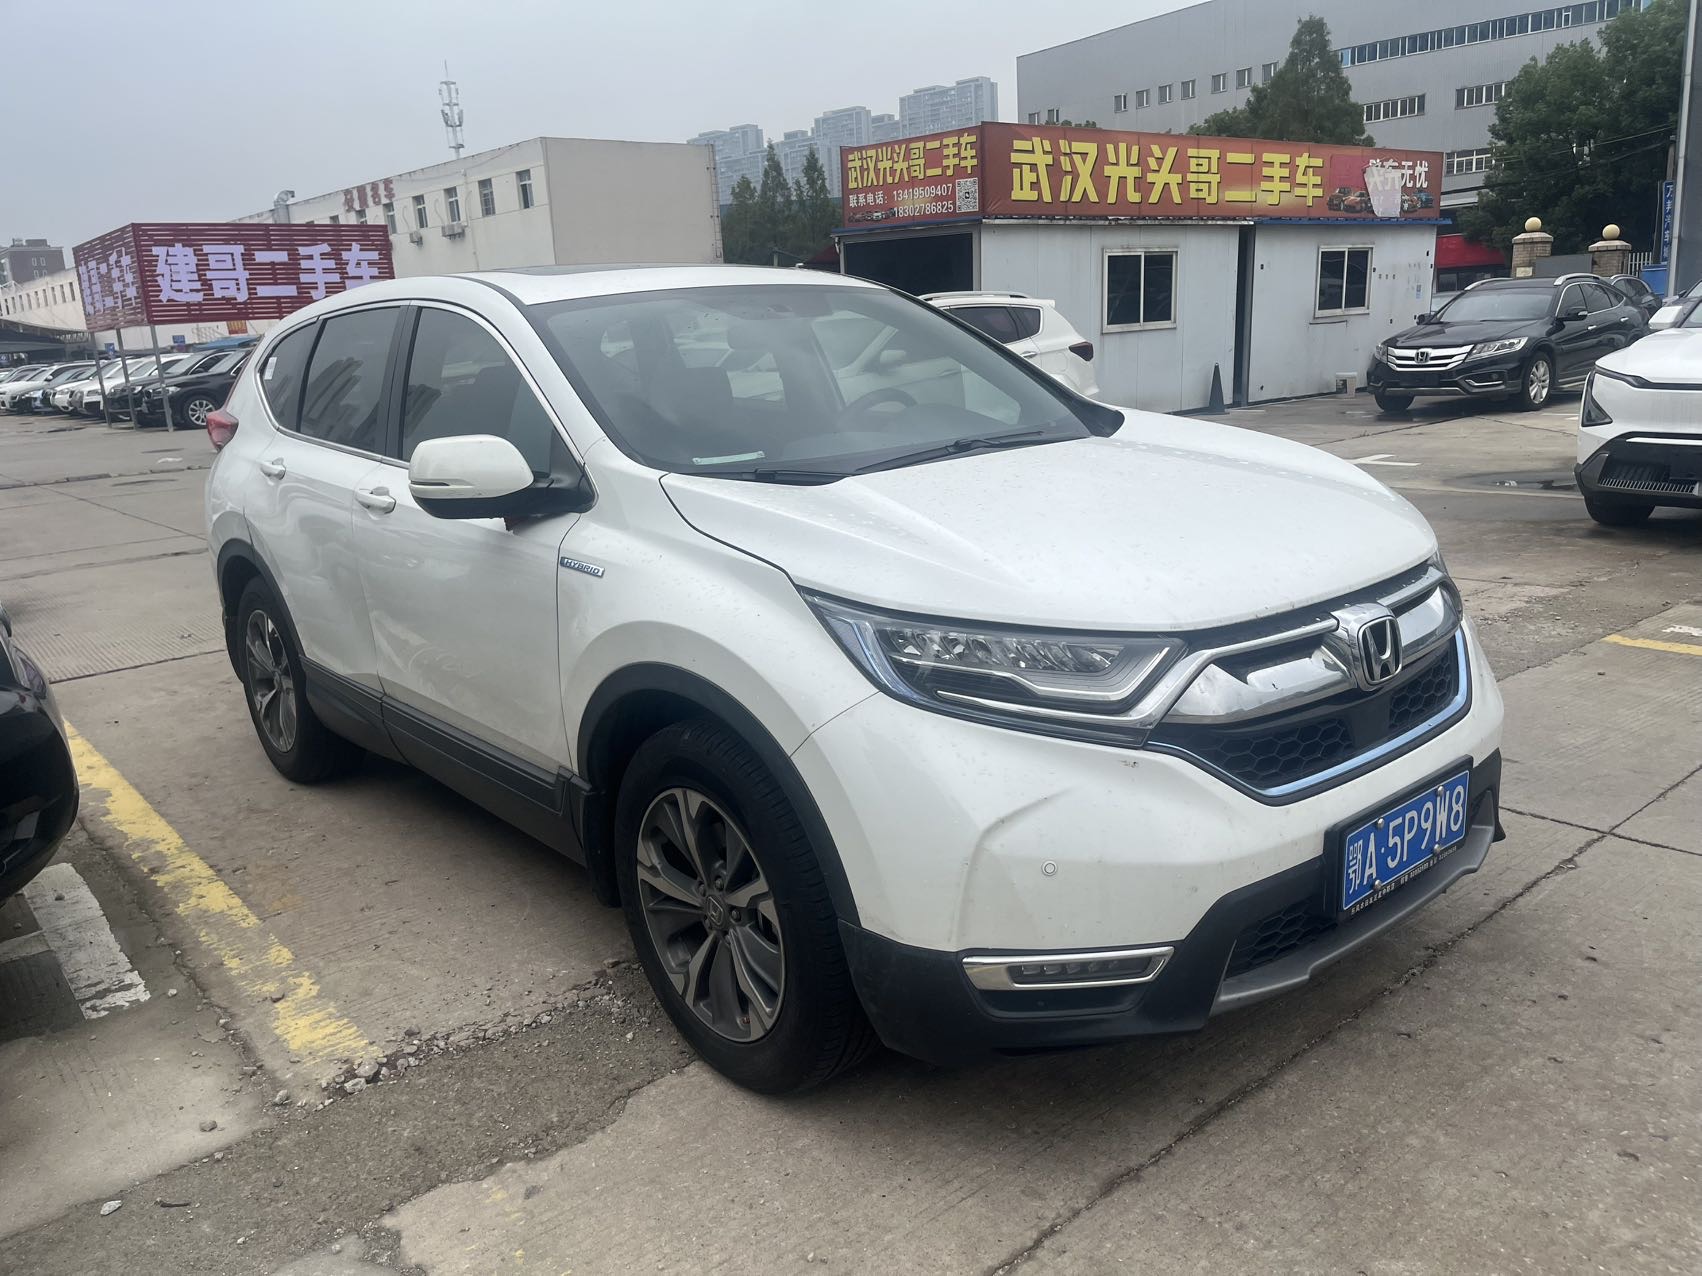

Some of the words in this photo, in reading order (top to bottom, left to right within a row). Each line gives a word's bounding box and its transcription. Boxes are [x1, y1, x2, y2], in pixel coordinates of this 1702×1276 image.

[847, 132, 979, 189] 武汉光头哥二手车
[1010, 137, 1323, 206] 武汉光头哥二手车
[893, 184, 953, 201] 13419509407
[894, 201, 954, 217] 18302786825
[152, 242, 380, 303] 建哥二手车
[564, 559, 601, 576] HYBRID
